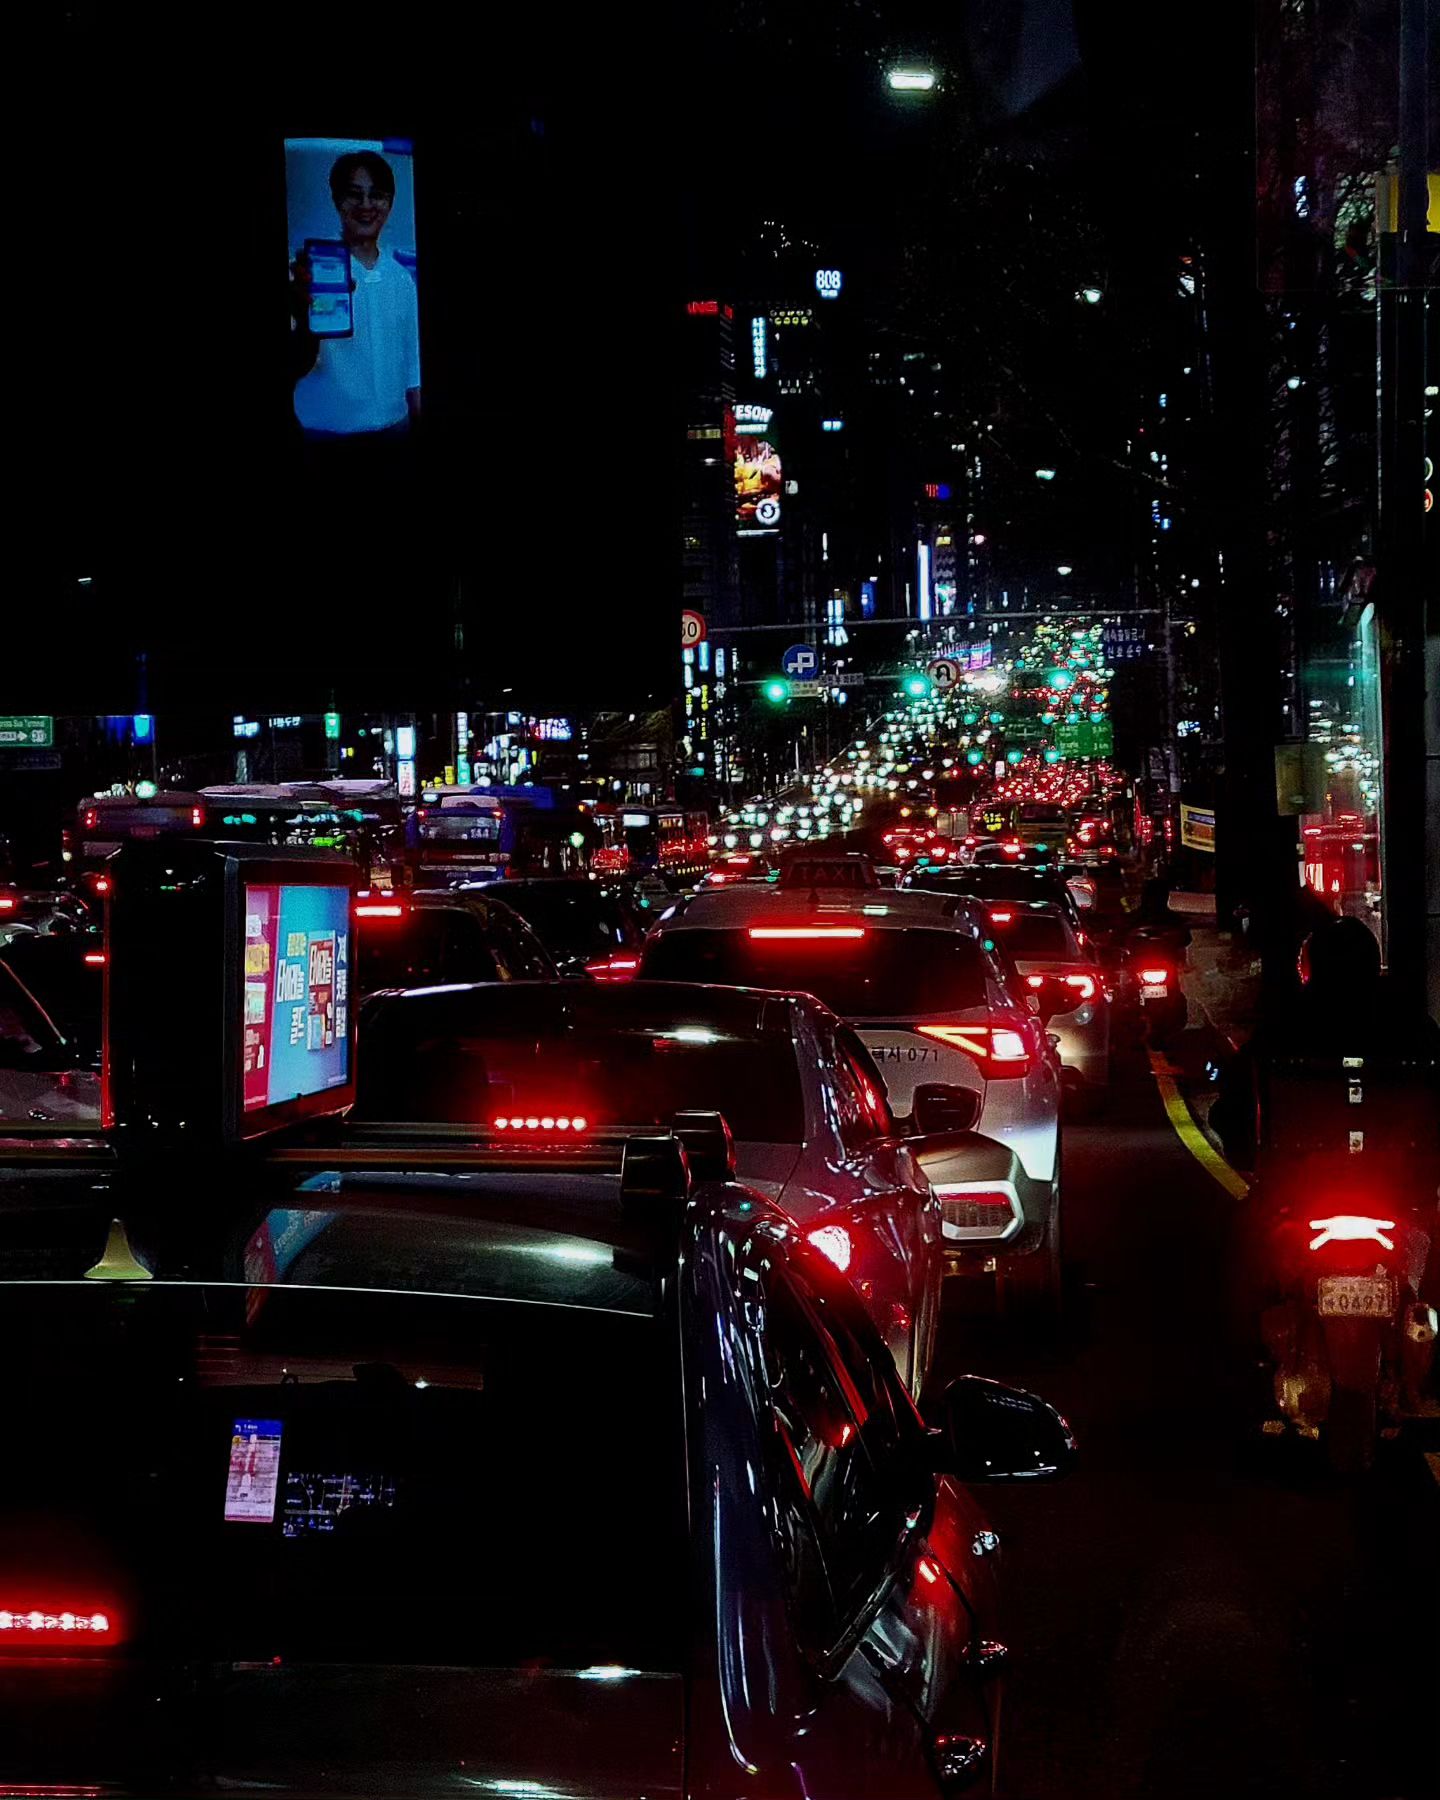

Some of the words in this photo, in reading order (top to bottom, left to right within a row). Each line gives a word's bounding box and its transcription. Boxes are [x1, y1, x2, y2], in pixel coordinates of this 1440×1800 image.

[816, 269, 841, 289] 808
[799, 865, 856, 881] TAXI
[871, 1046, 901, 1063] 택시
[908, 1047, 939, 1062] 071
